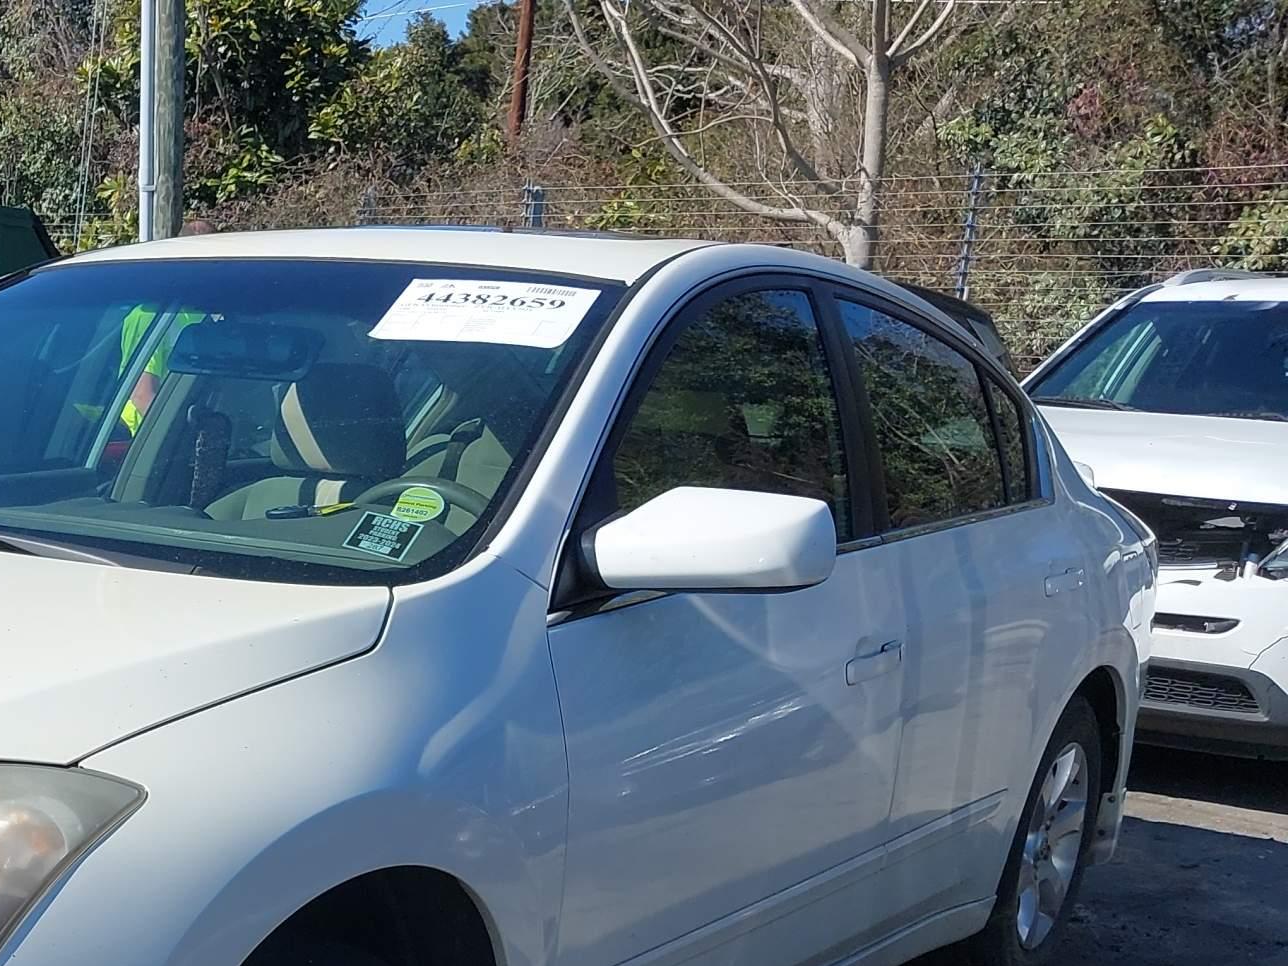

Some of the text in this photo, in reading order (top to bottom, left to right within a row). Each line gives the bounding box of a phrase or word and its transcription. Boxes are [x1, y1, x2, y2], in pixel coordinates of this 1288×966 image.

[415, 291, 567, 311] 44382659
[371, 516, 411, 533] RCHS
[373, 526, 400, 536] STUDENT
[357, 533, 402, 549] 2023-2024
[369, 530, 398, 541] PARKING
